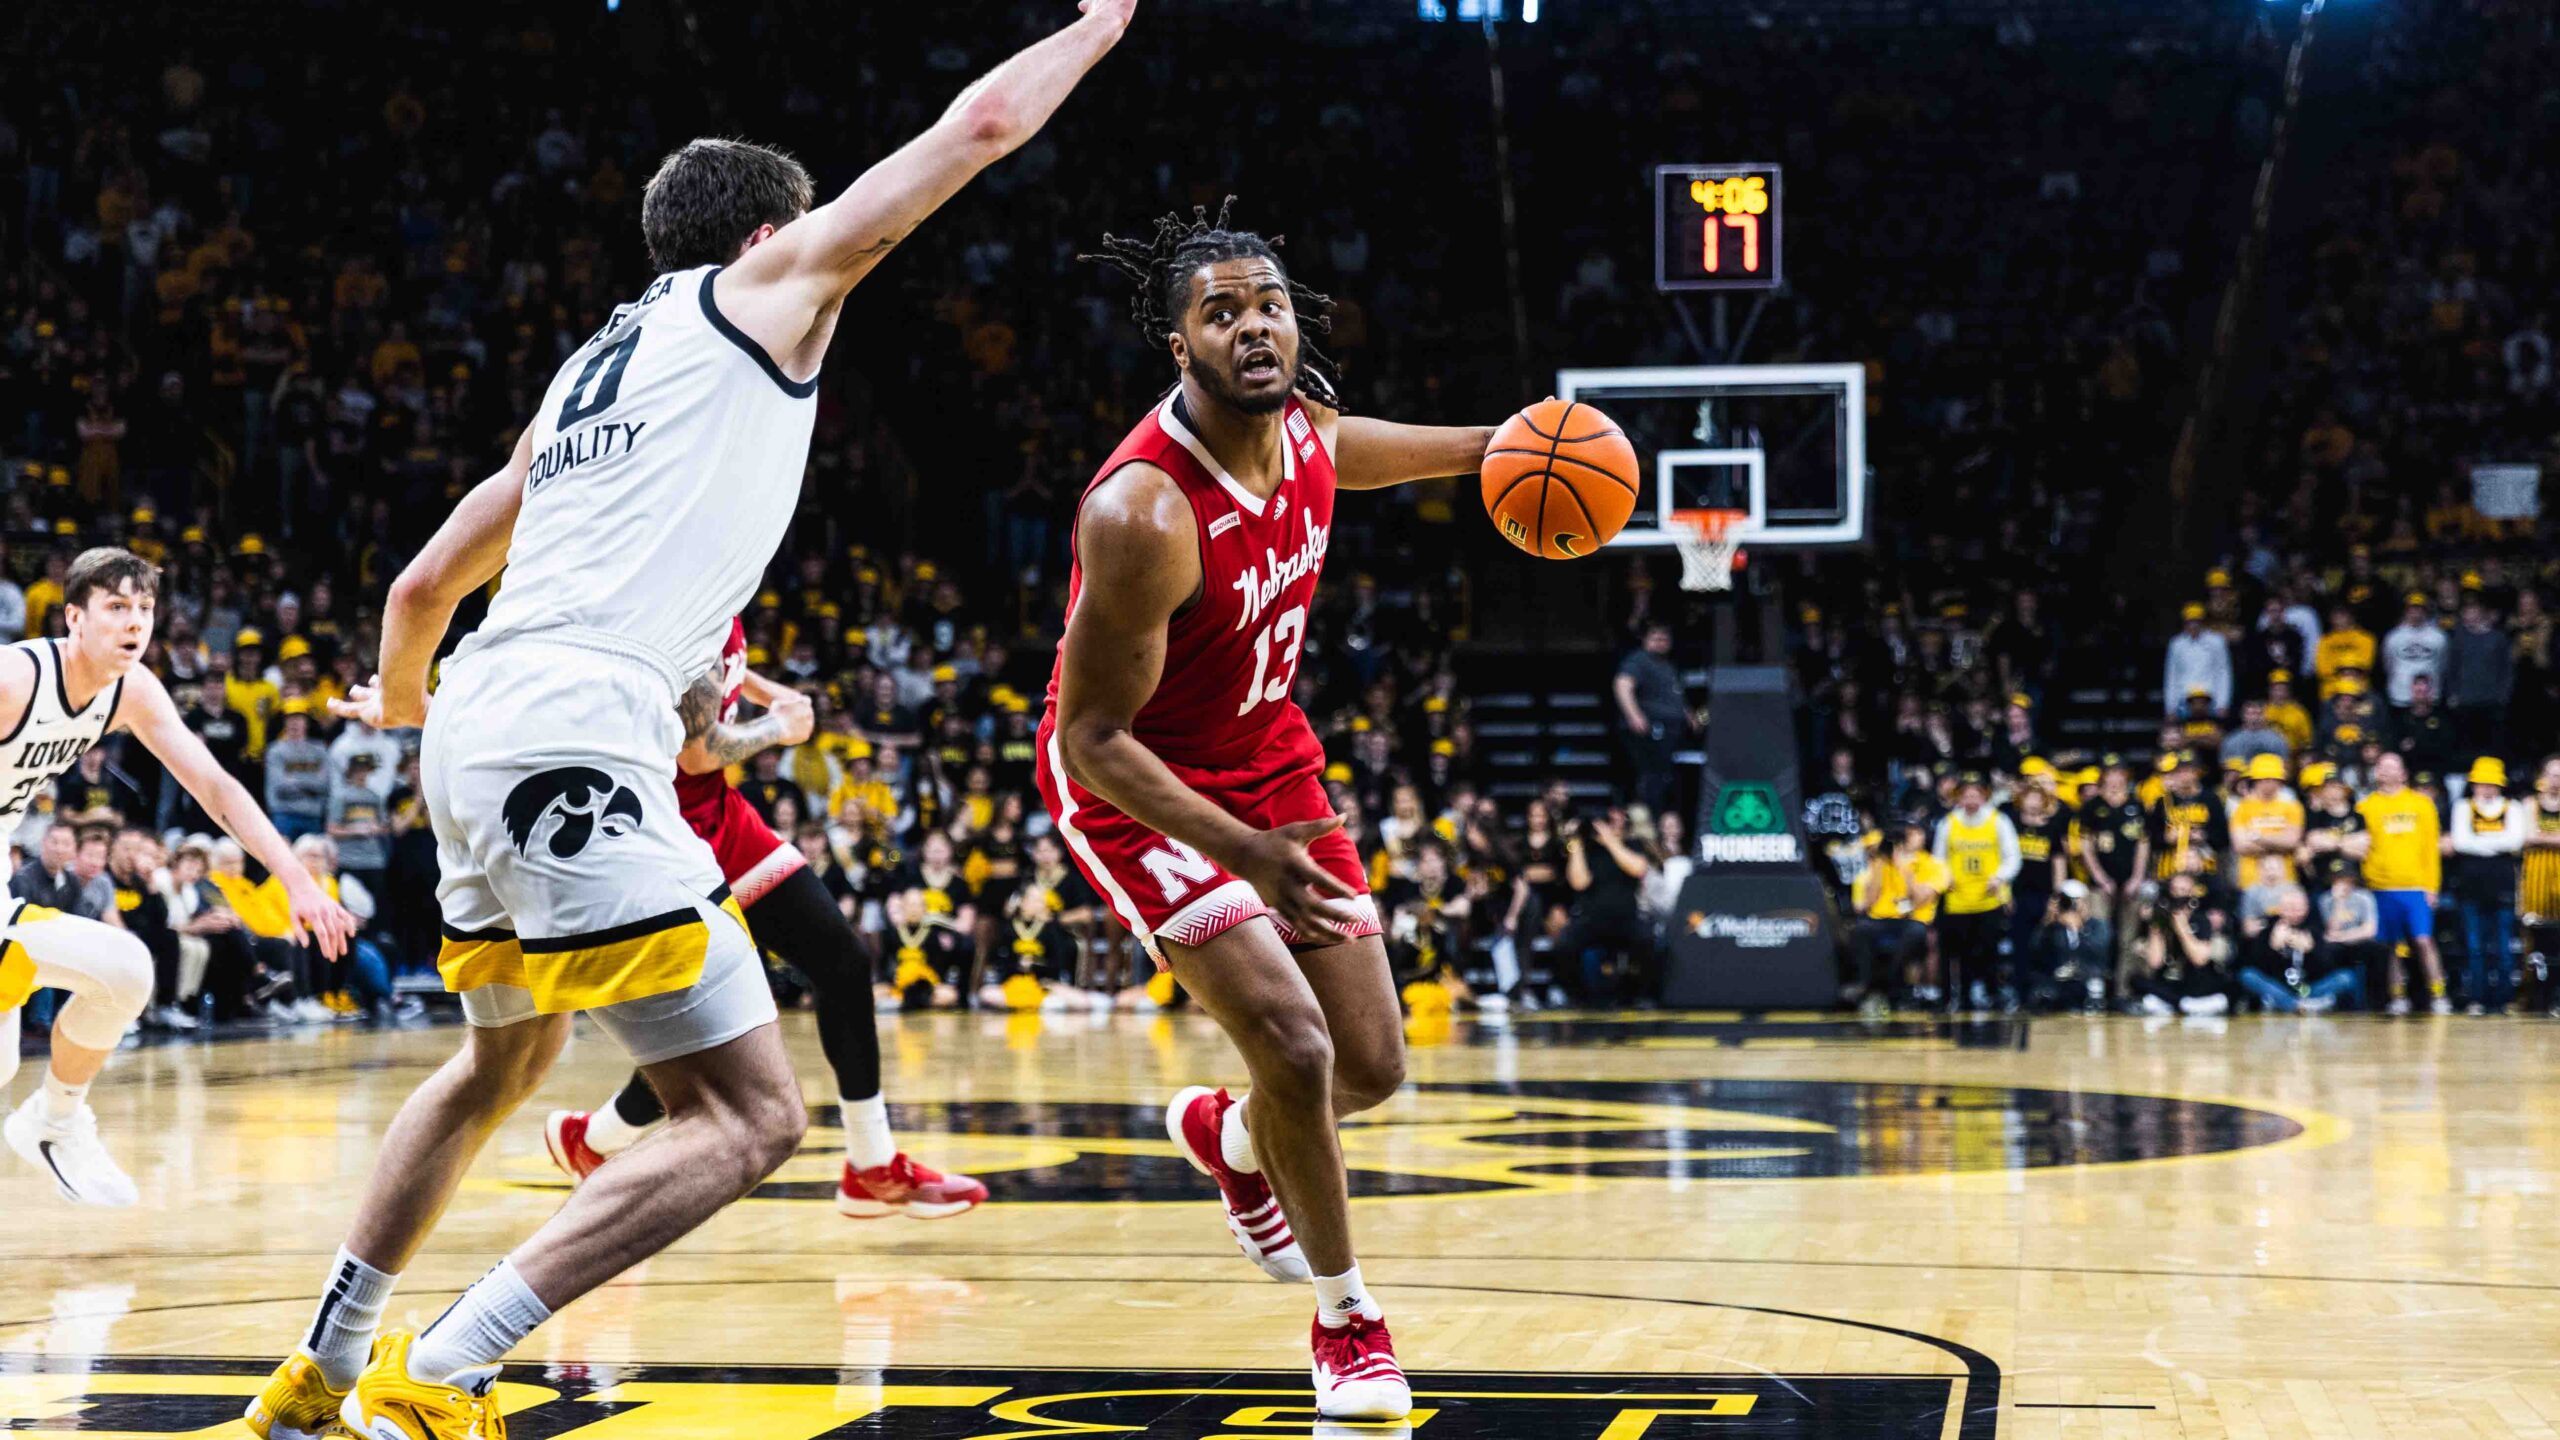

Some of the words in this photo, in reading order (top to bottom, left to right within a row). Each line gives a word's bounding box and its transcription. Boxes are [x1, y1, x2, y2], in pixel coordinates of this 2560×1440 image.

[1690, 176, 1768, 214] 4:06
[1703, 213, 1758, 272] 17
[556, 325, 642, 432] 0
[1233, 507, 1328, 631] Nebraska
[1237, 604, 1305, 717] 13
[13, 737, 91, 768] IOWA
[1139, 837, 1218, 905] N
